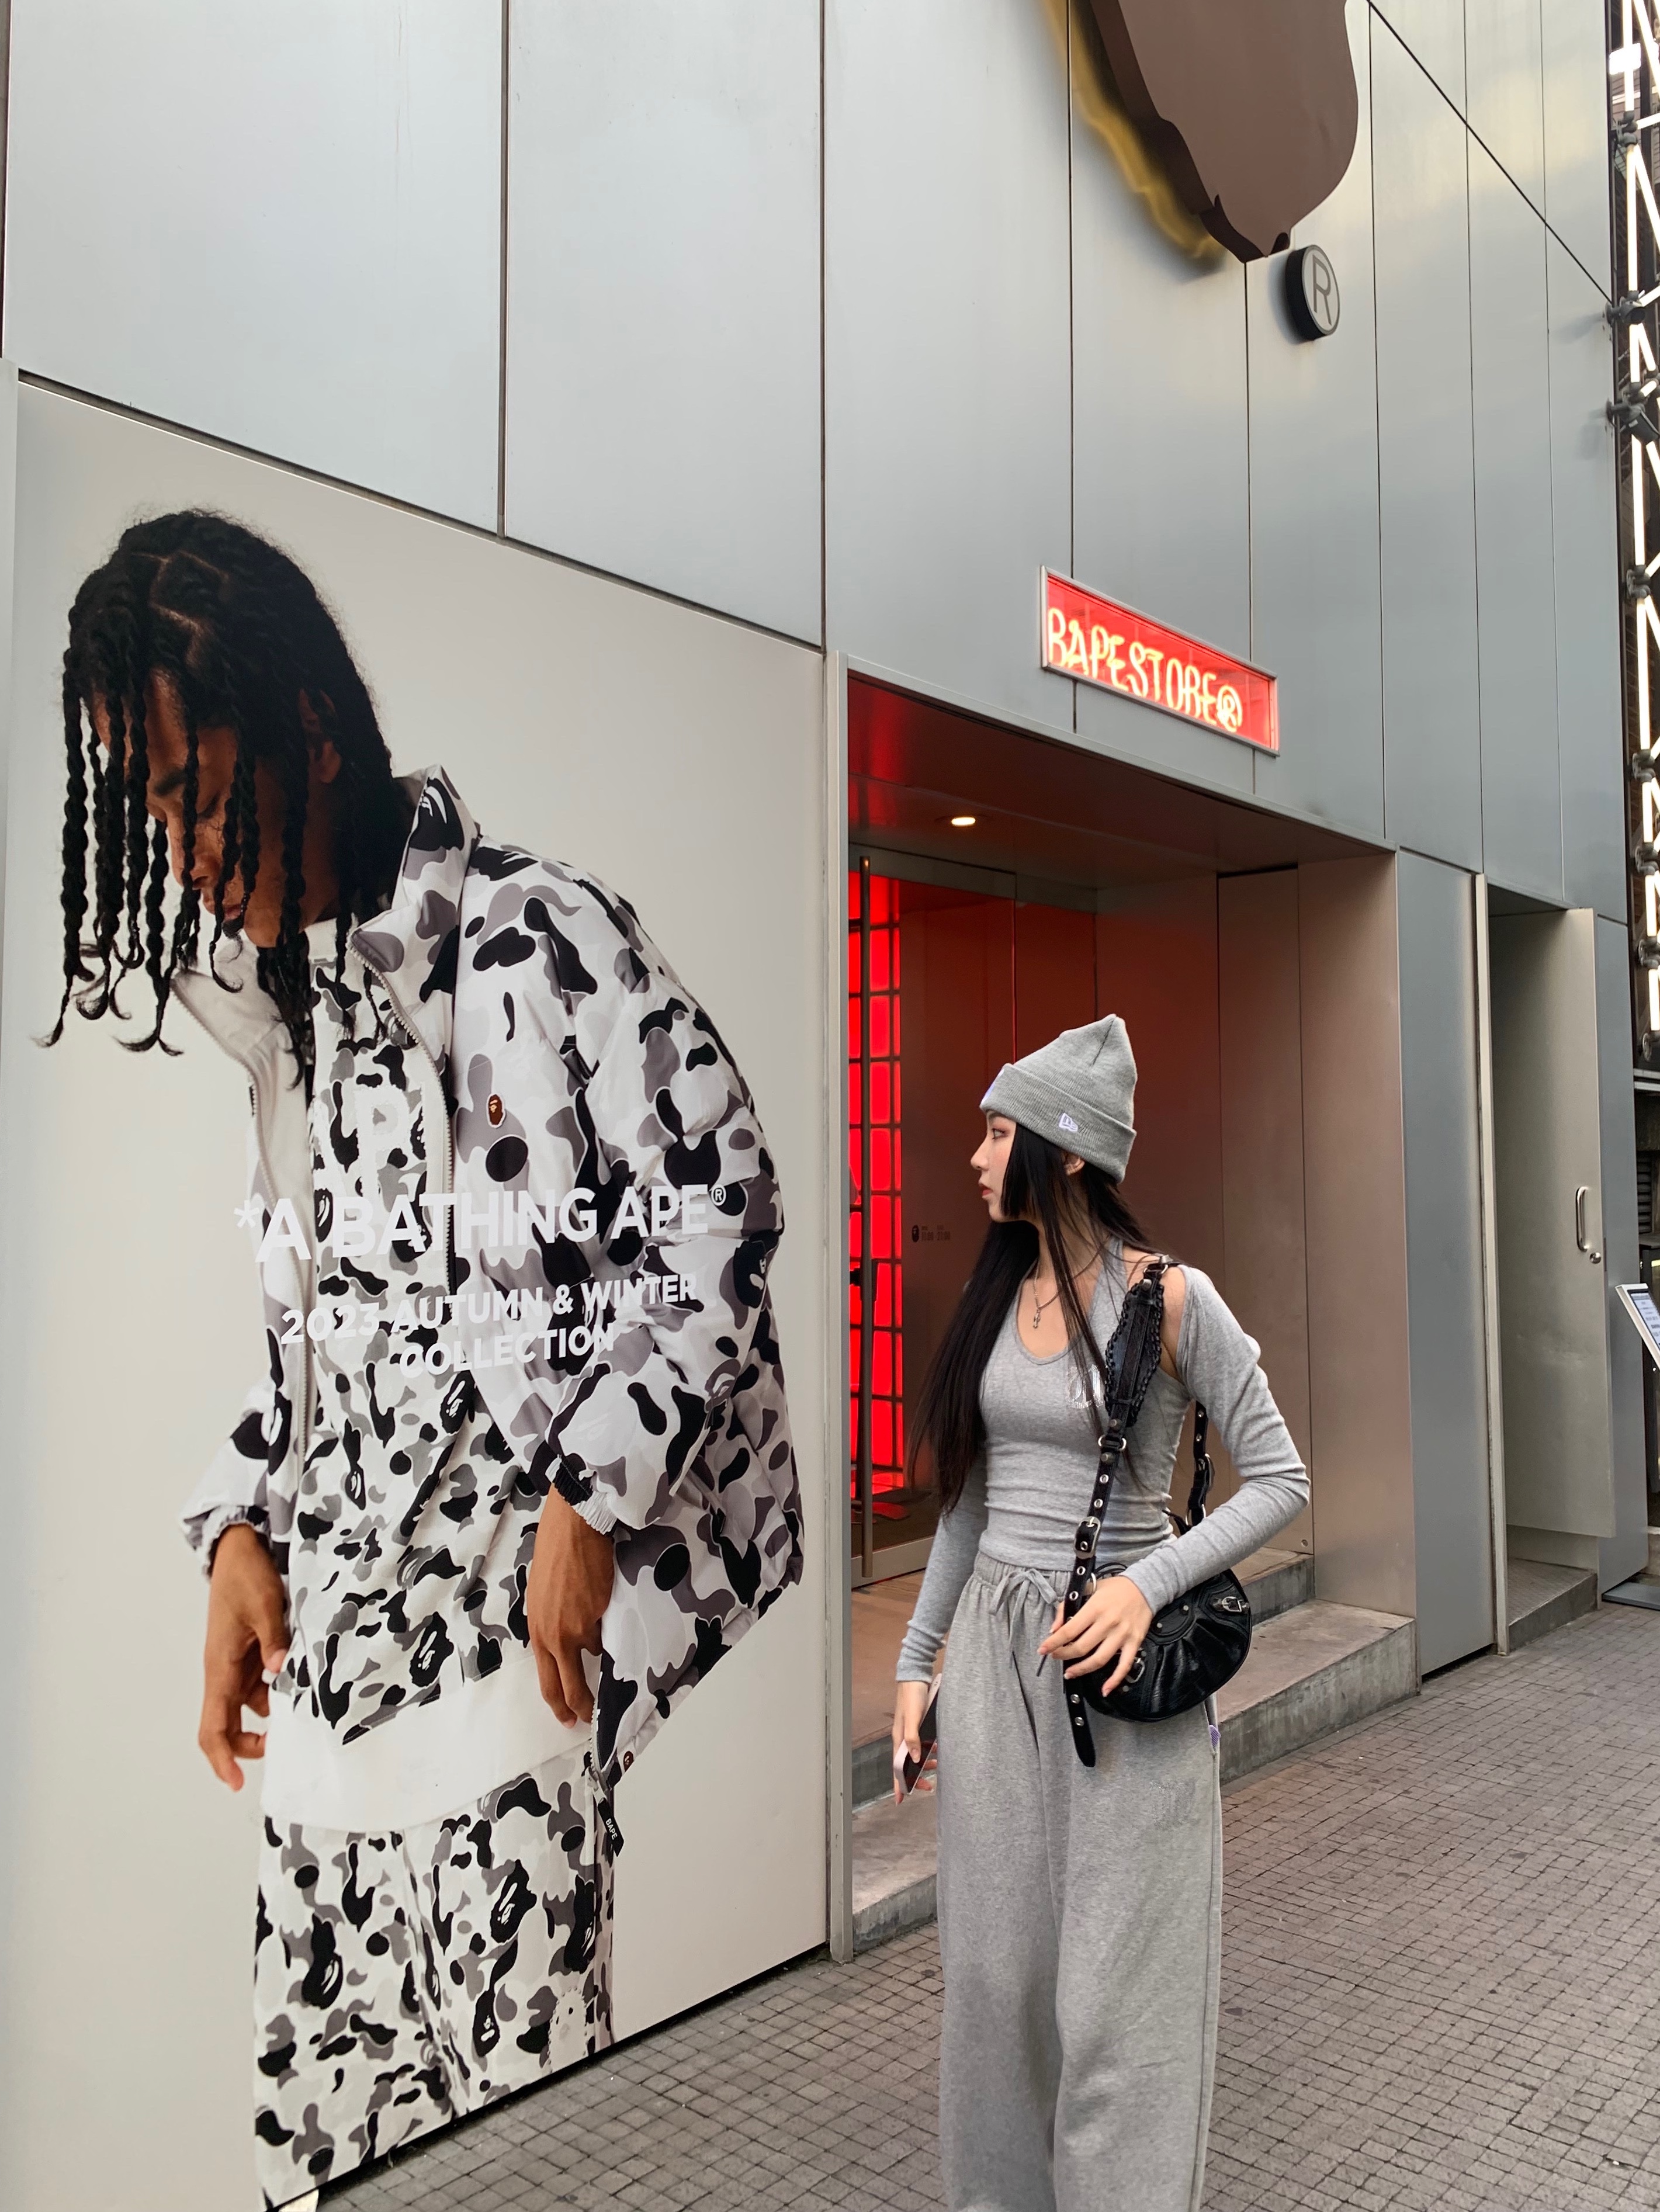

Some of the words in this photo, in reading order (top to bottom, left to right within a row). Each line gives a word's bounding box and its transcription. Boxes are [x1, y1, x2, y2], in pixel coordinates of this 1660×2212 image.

[332, 1188, 598, 1258] BATHING
[280, 1302, 380, 1344] 2023
[390, 1287, 543, 1333] AUTUMN
[553, 1284, 574, 1315] &
[581, 1274, 697, 1312] WINTER
[400, 1323, 614, 1378] COLLECTION
[605, 1818, 618, 1840] BAPE
